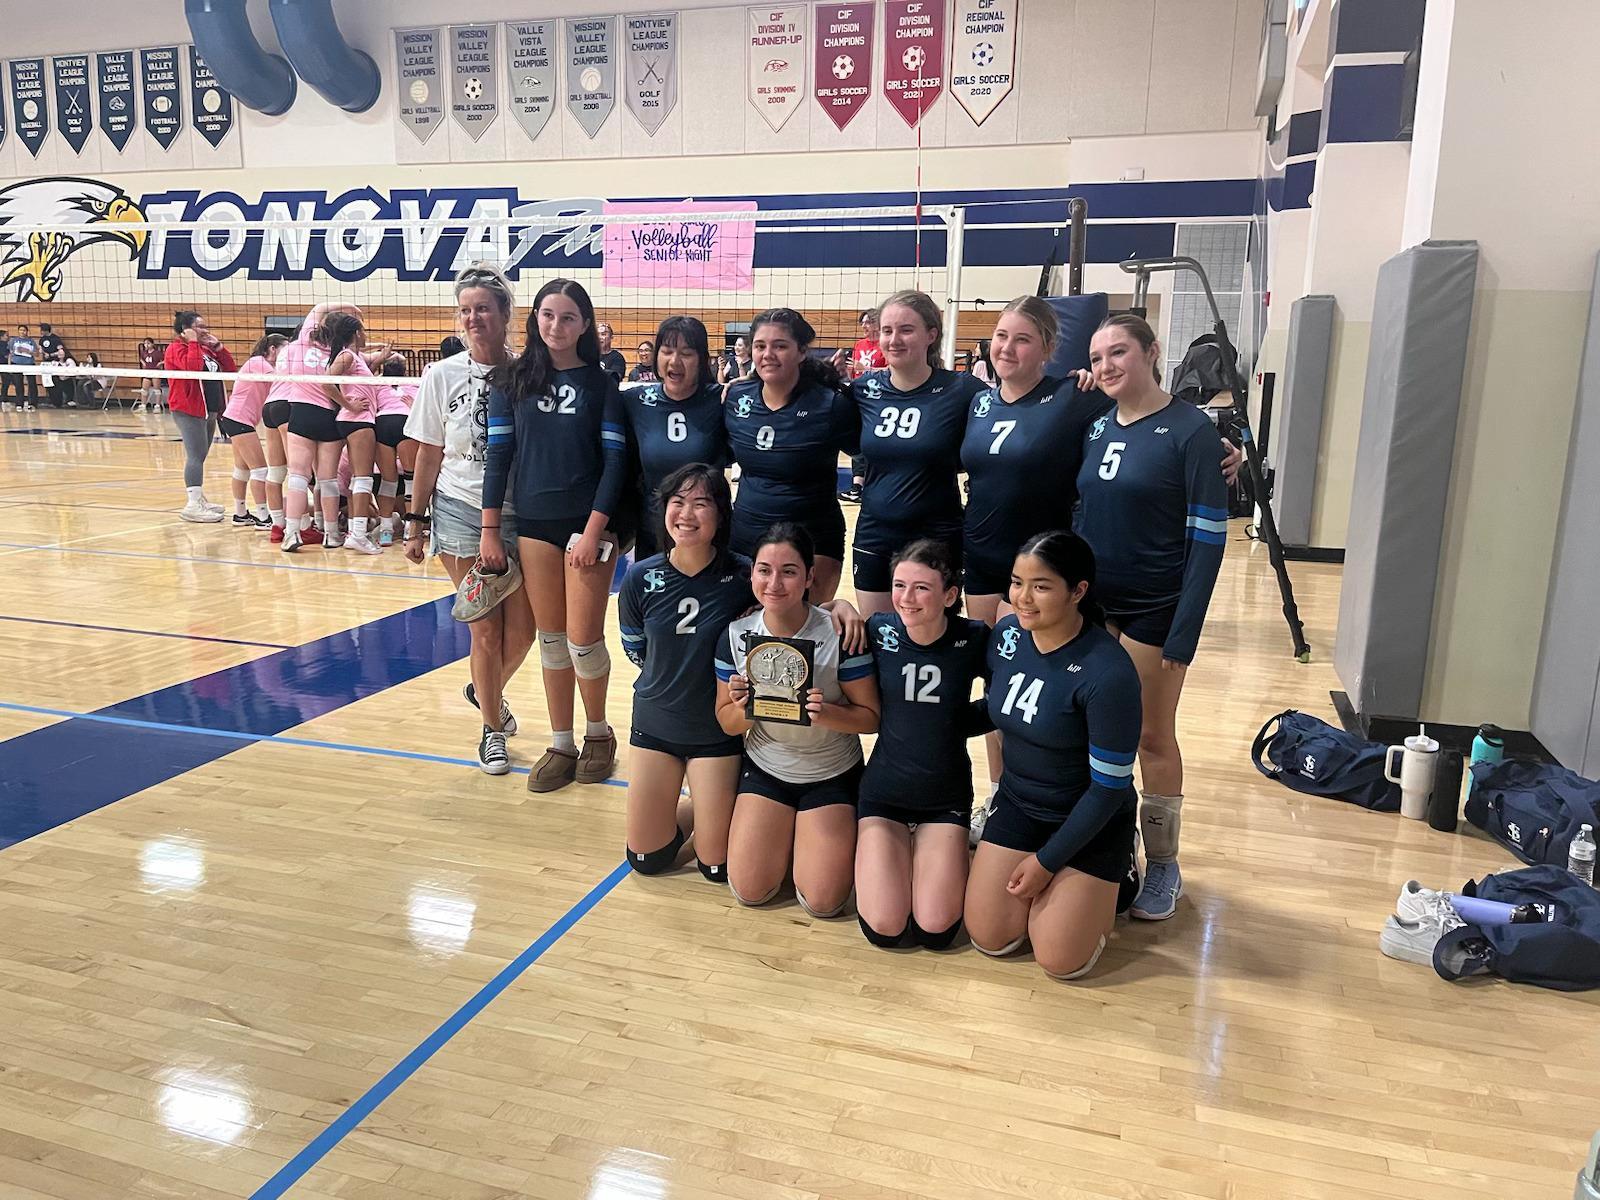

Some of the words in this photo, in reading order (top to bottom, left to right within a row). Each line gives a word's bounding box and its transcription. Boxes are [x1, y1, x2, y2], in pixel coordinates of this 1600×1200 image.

[906, 3, 924, 13] CIF
[978, 0, 995, 9] CIF
[769, 12, 784, 21] CIF
[837, 9, 853, 19] CIF
[966, 11, 1005, 22] REGIONAL
[628, 19, 672, 28] MONTVIEW
[899, 15, 931, 26] DIVISION
[517, 25, 544, 35] VALLE
[574, 22, 606, 32] MISSION
[758, 24, 786, 34] DIVISION
[788, 23, 796, 32] IV
[830, 23, 860, 33] DIVISION
[965, 24, 1004, 35] CHAMPION
[403, 34, 433, 43] MISSION
[457, 30, 488, 39] MISSION
[575, 33, 606, 43] VALLEY
[633, 30, 668, 40] LEAGUE
[895, 28, 934, 39] CHAMPION
[458, 41, 488, 50] VALLEY
[519, 36, 542, 46] VISTA
[751, 35, 803, 46] RUNNER-UP
[823, 36, 865, 48] CHAMPIONS
[404, 45, 433, 54] VALLEY
[574, 44, 607, 54] LEAGUE
[631, 41, 669, 51] CHAMPIONS
[514, 47, 547, 57] LEAGUE
[104, 55, 125, 64] VALLE
[403, 57, 434, 66] LEAGUE
[458, 53, 489, 62] LEAGUE
[572, 56, 608, 66] CHAMPIONS
[147, 62, 172, 71] VALLEY
[513, 58, 549, 68] CHAMPIONS
[60, 69, 84, 77] LEAGUE
[106, 65, 125, 73] VISTA
[402, 68, 436, 78] CHAMPIONS
[456, 65, 491, 74] CHAMPIONS
[103, 74, 129, 83] LEAGUE
[147, 72, 174, 81] LEAGUE
[953, 76, 975, 86] GIRLS
[979, 74, 1010, 85] SOCCER
[17, 81, 41, 89] LEAGUE
[146, 82, 176, 91] CHAMPIONS
[886, 80, 908, 90] GIRLS
[911, 77, 941, 89] SOCCER
[639, 90, 661, 98] GOLF
[817, 88, 838, 96] GIRLS
[840, 86, 868, 95] SOCCER
[970, 88, 992, 96] 2020
[831, 97, 851, 106] 2014
[472, 103, 496, 111] SOCCER
[150, 117, 177, 125] FOOTBALL
[145, 197, 513, 272] TONGVA
[632, 223, 719, 253] Volleyball
[643, 248, 683, 263] SENIOR
[667, 411, 687, 443] 6
[873, 406, 921, 439] 39
[755, 425, 776, 451] 9
[988, 419, 1017, 455] 7
[1097, 441, 1127, 481] 5
[675, 596, 701, 635] 2
[901, 662, 942, 704] 12
[1000, 671, 1045, 725] 14
